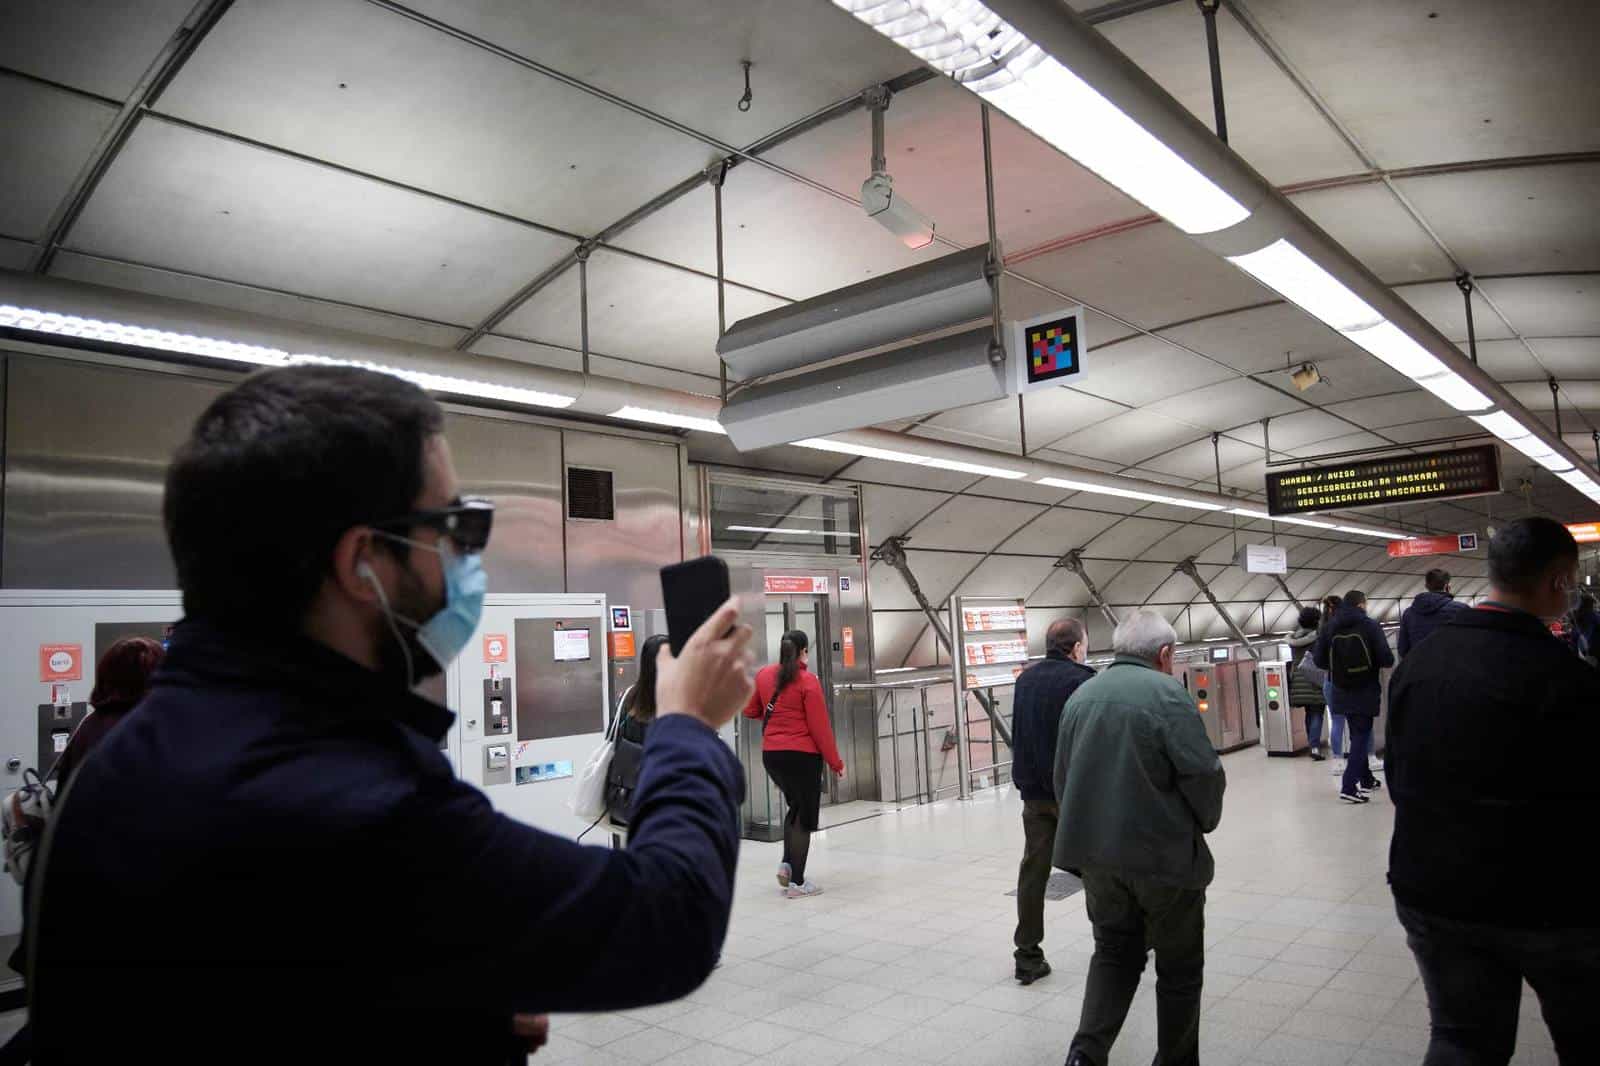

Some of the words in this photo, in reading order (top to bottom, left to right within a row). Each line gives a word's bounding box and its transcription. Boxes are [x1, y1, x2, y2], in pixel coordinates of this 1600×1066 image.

[1327, 470, 1356, 480] AVISO
[1396, 472, 1439, 483] MASKARA
[1297, 498, 1315, 507] USO
[1319, 490, 1381, 504] OBLIGATORIO
[1386, 483, 1446, 497] MASCARILLA
